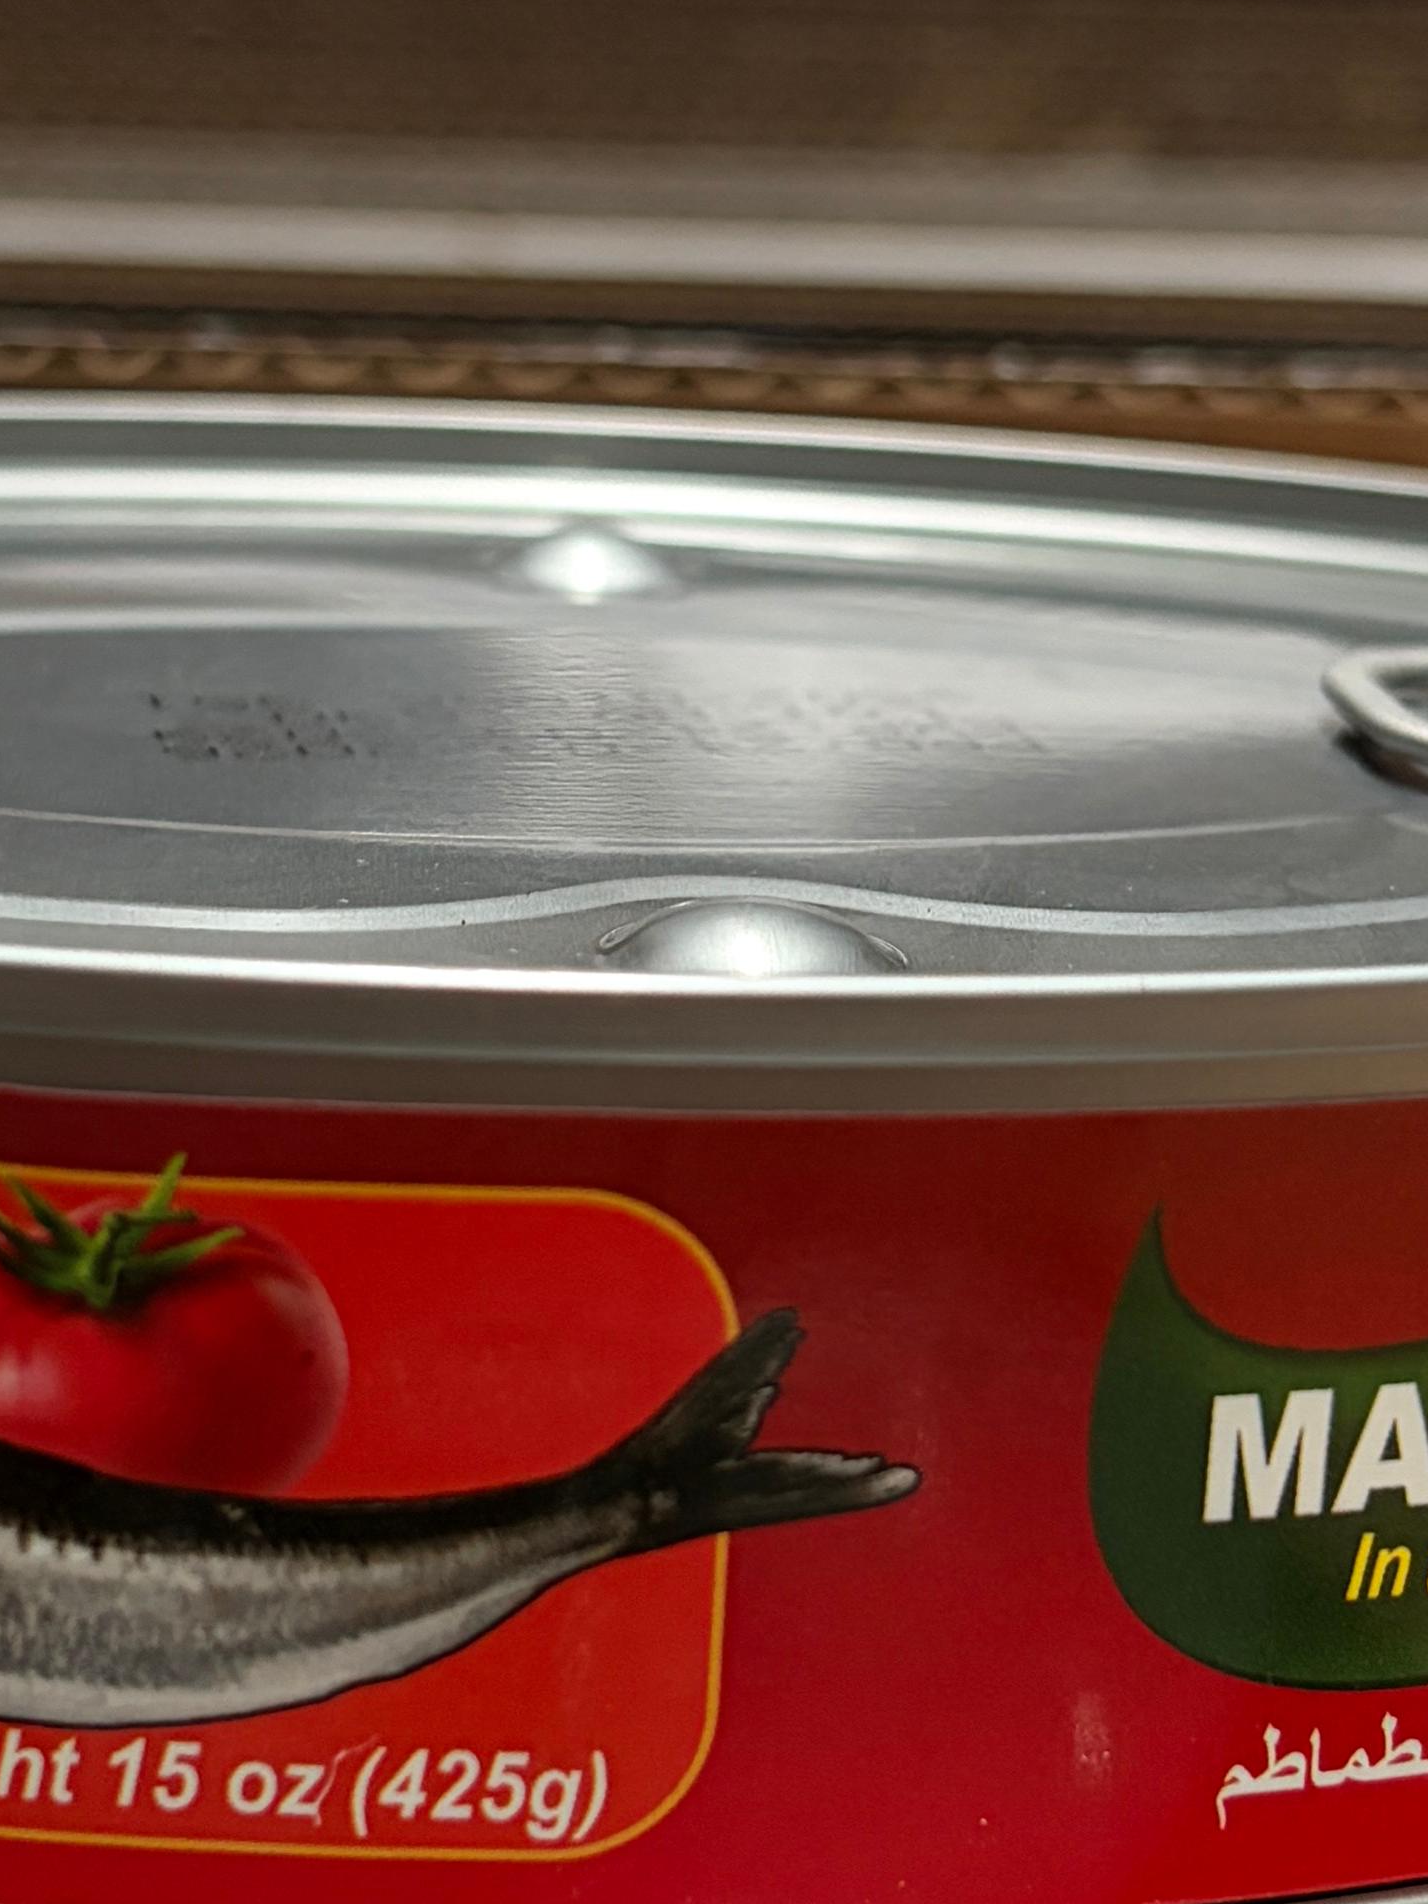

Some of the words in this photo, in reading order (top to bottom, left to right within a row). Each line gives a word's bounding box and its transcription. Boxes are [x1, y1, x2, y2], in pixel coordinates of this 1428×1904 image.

[1344, 1531, 1414, 1602] In
[109, 1737, 202, 1812] 15
[227, 1761, 322, 1818] oz
[350, 1744, 609, 1842] (425g)
